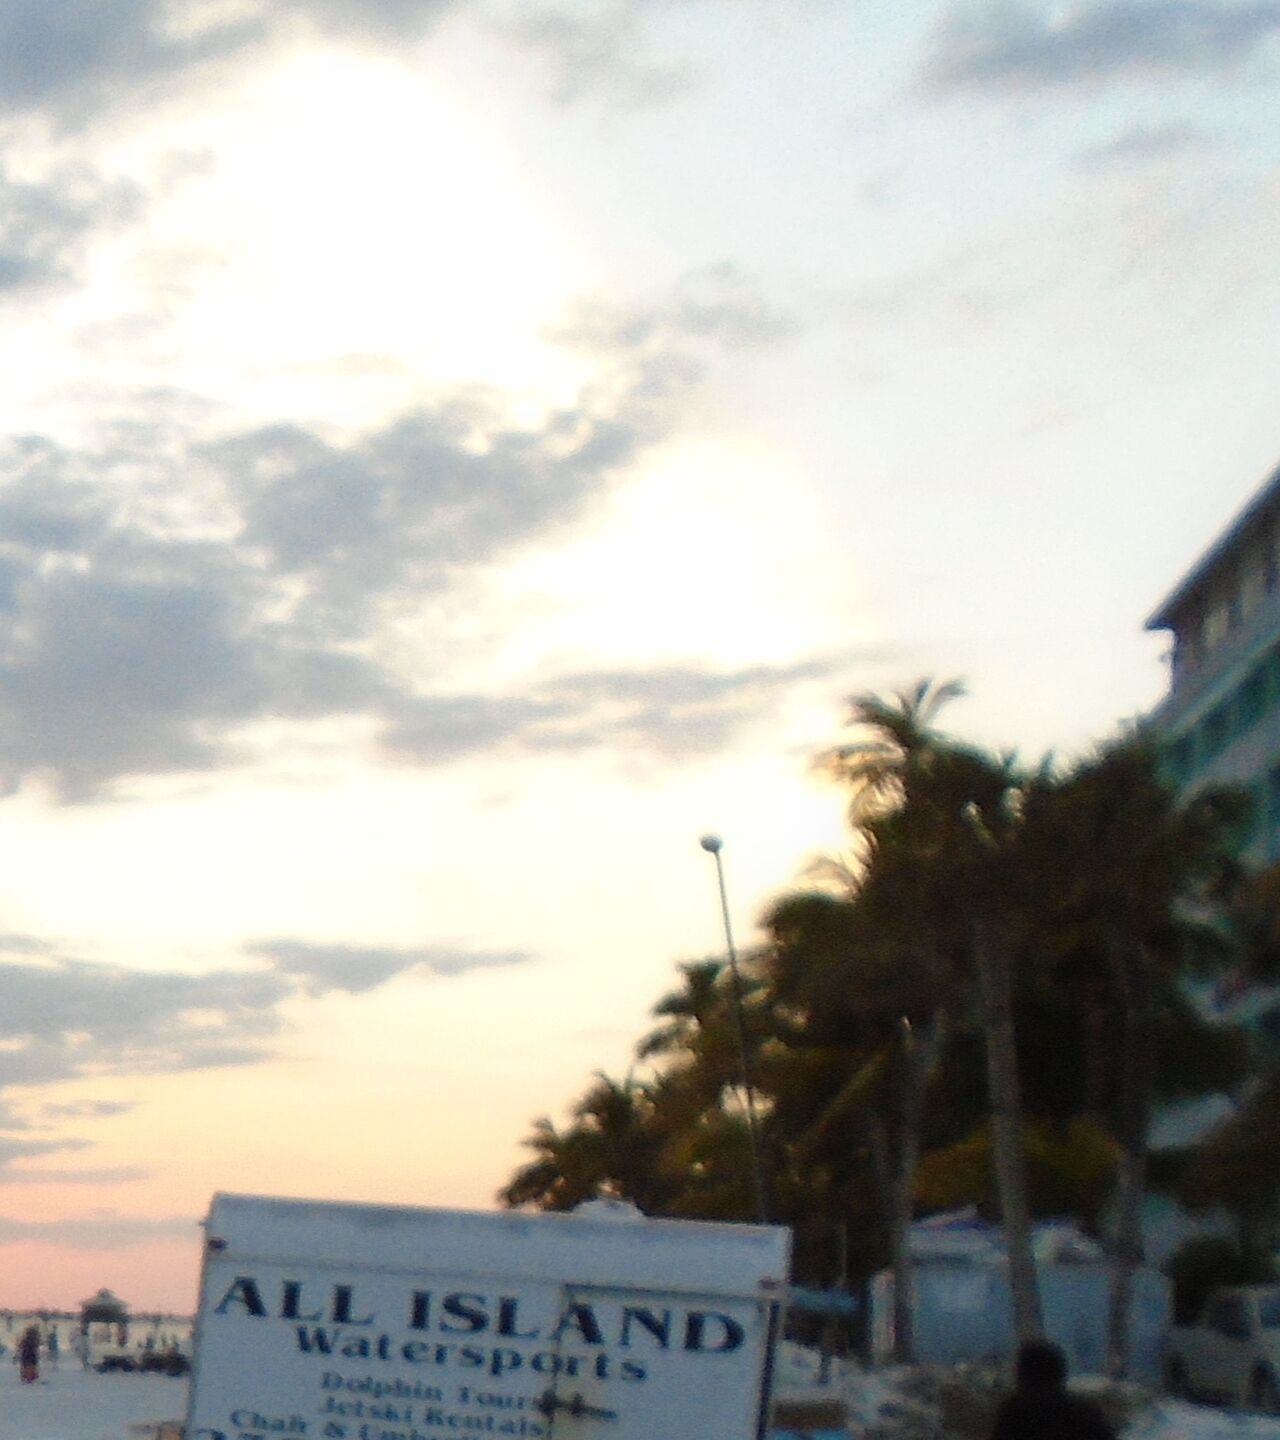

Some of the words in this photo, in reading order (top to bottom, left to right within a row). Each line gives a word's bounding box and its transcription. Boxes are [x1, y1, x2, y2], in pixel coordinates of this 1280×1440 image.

[215, 1275, 375, 1326] ALL
[409, 1289, 745, 1352] ISLAND
[296, 1325, 647, 1380] Watersports
[322, 1371, 443, 1399] Dolphin
[426, 1406, 545, 1437] Rentals
